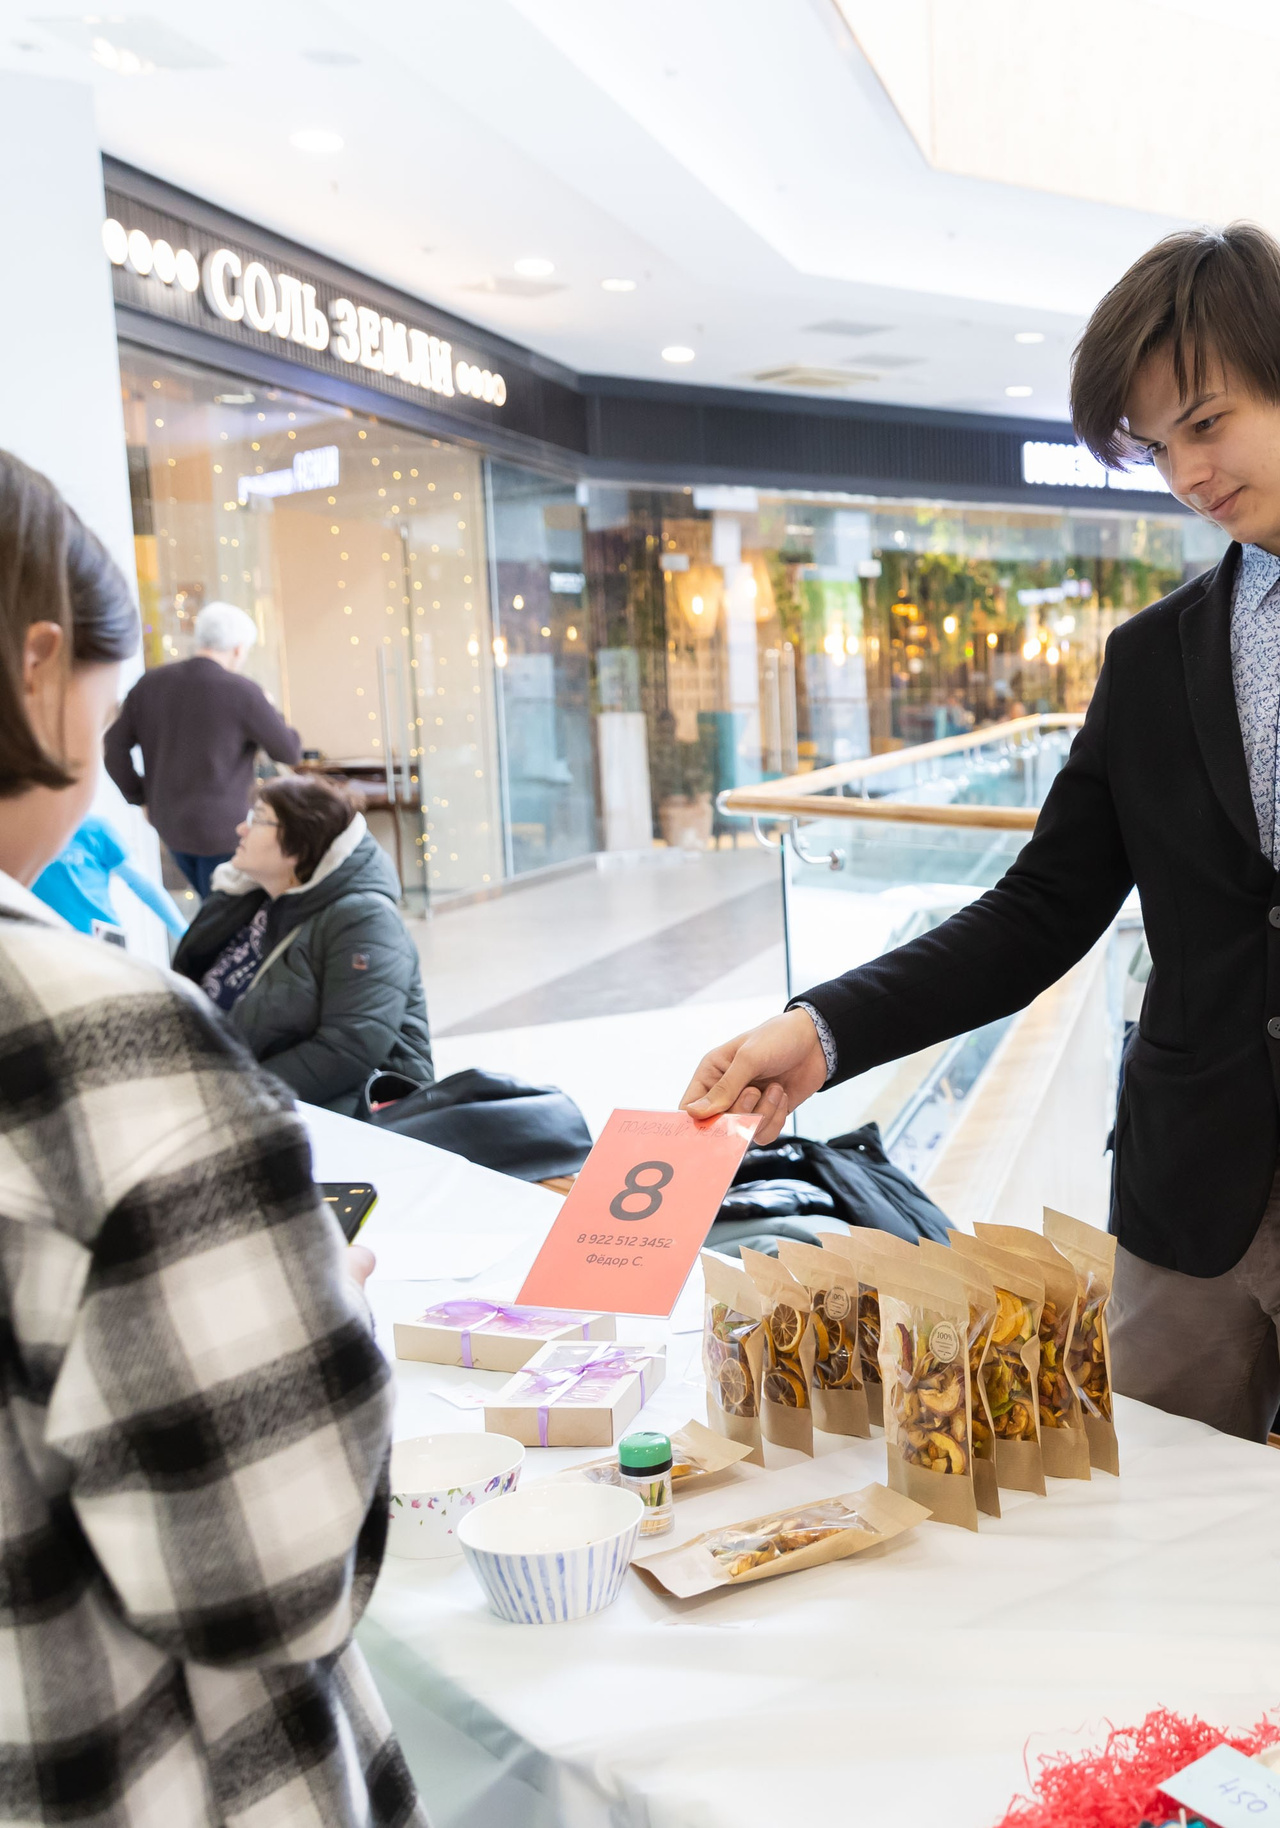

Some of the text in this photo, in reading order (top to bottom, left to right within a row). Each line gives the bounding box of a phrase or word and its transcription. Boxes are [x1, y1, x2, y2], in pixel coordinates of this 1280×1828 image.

[203, 248, 455, 398] СОЛЬ ЗЕМЛИ
[609, 1160, 675, 1222] 8
[577, 1233, 673, 1248] 8 922 512 3452
[586, 1253, 629, 1268] Фёдор
[936, 1331, 953, 1341] 100%
